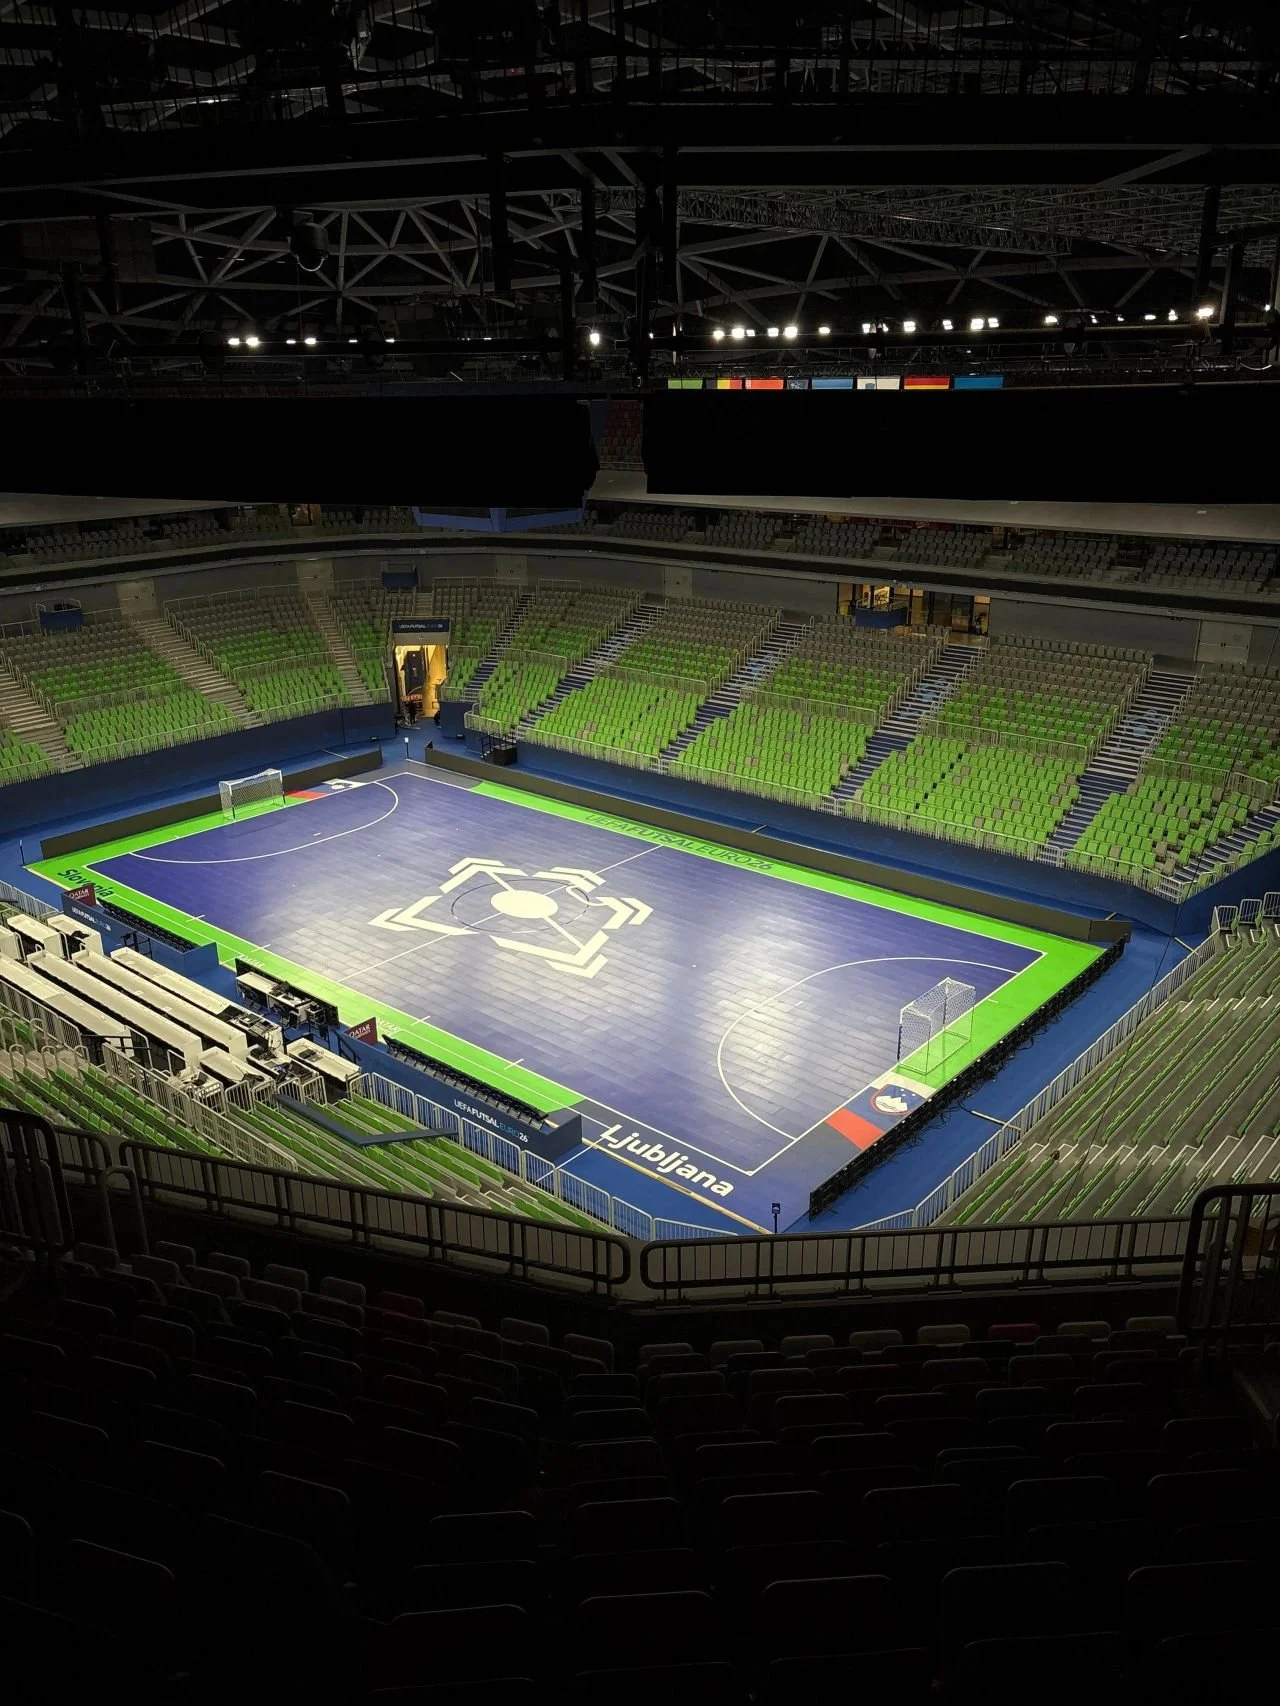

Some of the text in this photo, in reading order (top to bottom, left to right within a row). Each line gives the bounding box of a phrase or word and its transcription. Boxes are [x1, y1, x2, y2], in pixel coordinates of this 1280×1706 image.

[585, 814, 775, 871] UEFA FUTSAL EURO26
[57, 868, 114, 897] Slovnia
[69, 888, 89, 899] QATAR
[349, 1023, 370, 1038] QATAR
[471, 1108, 500, 1129] FUTSAL
[600, 1123, 735, 1197] Ljubljana
